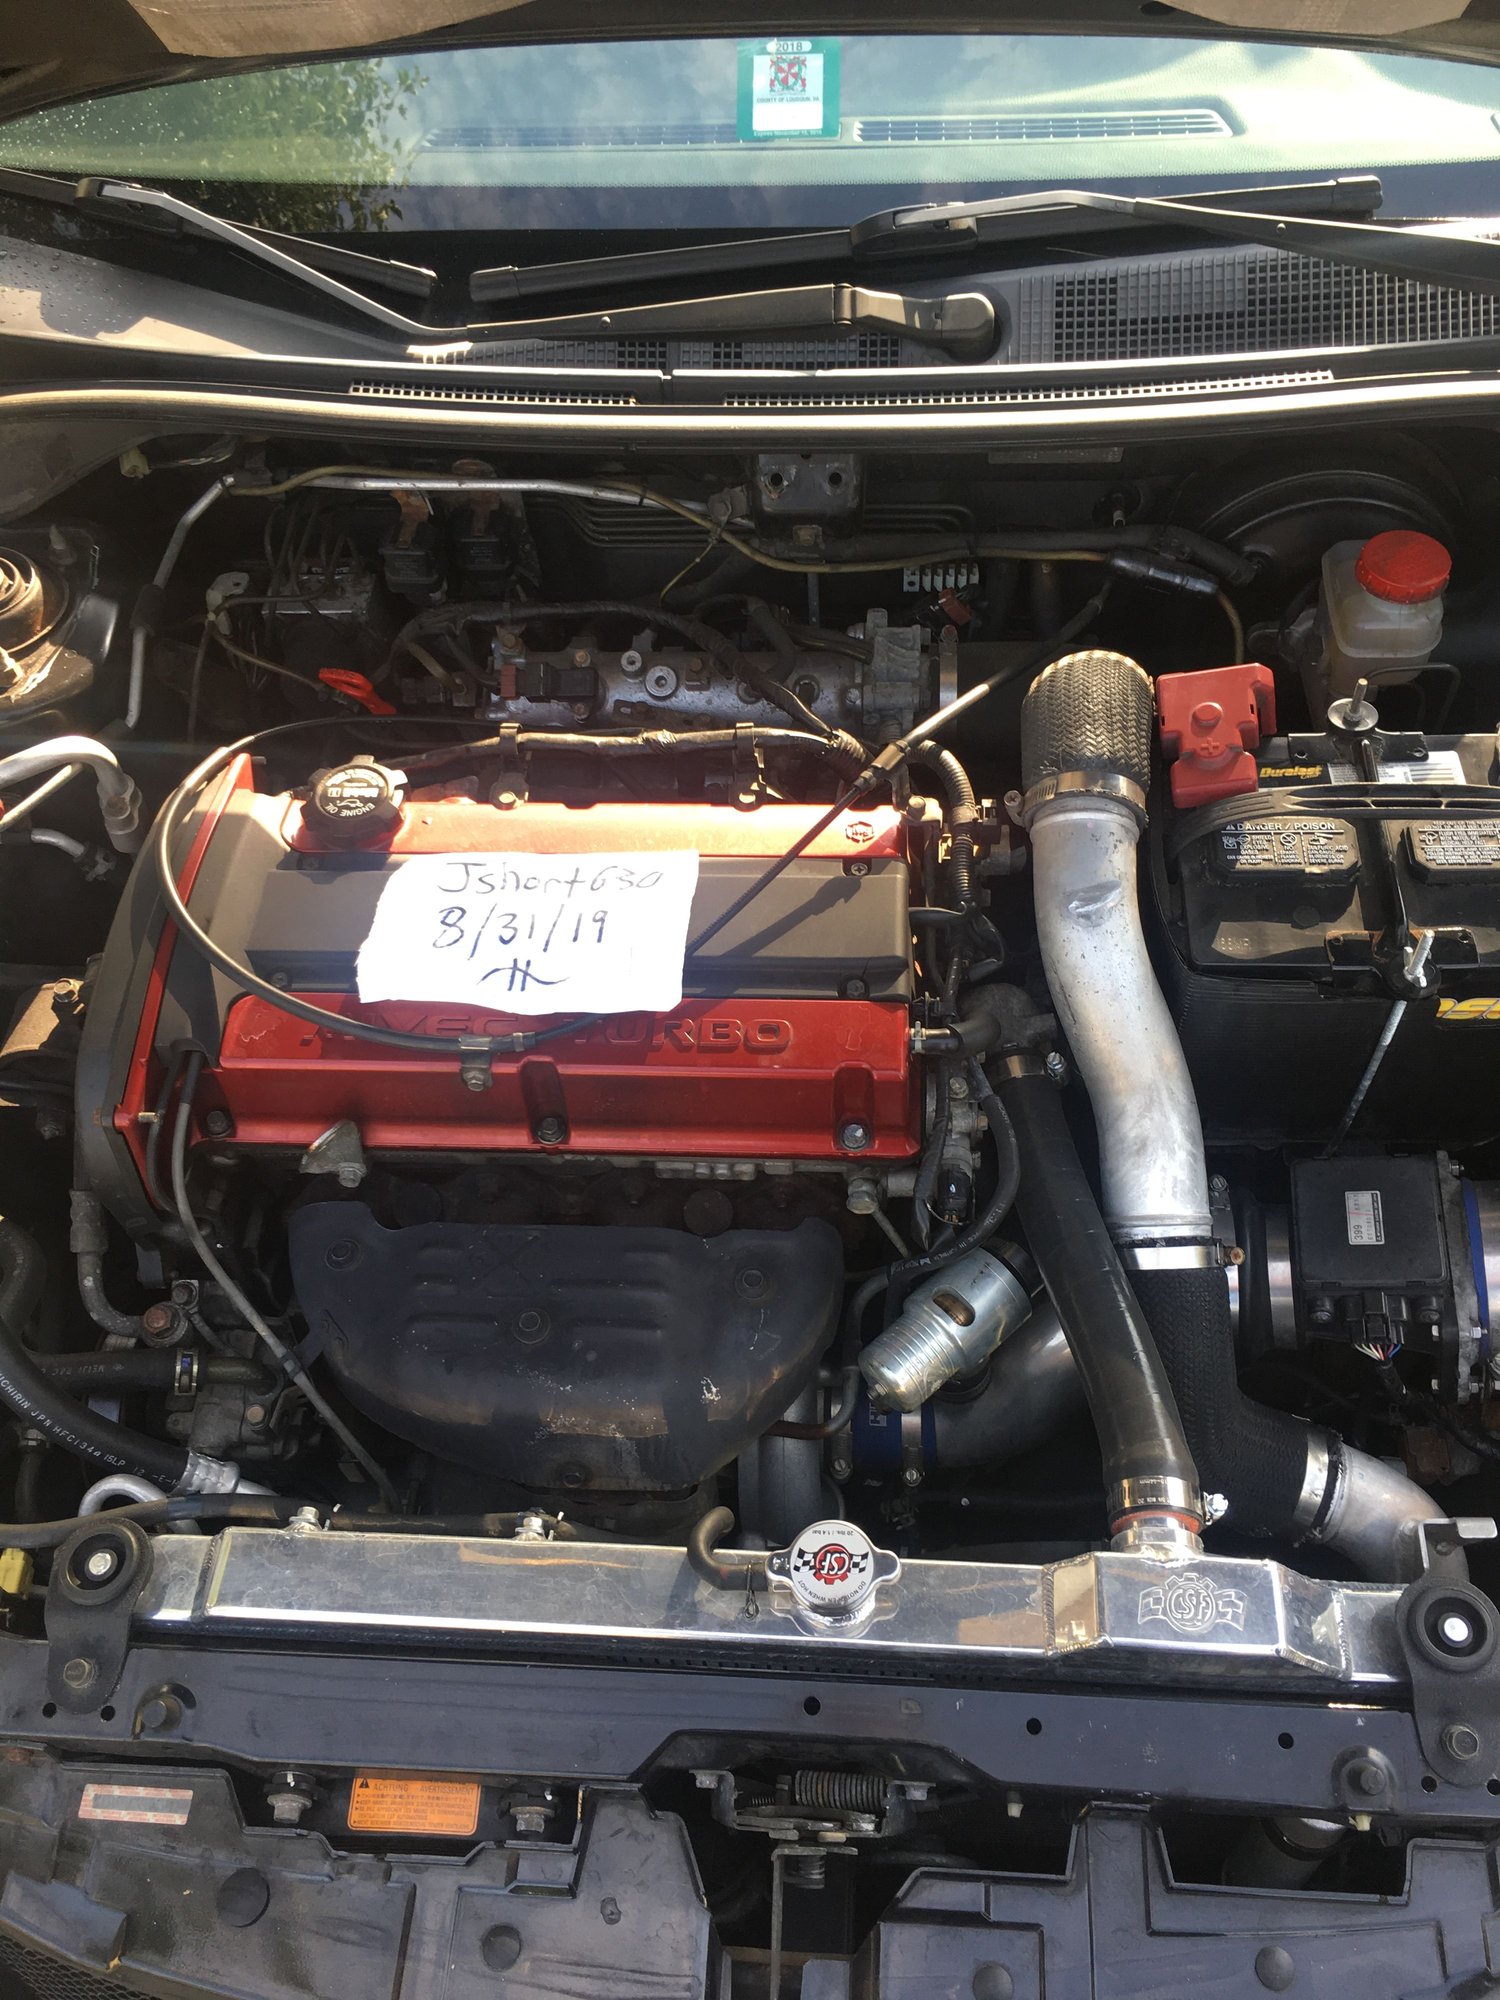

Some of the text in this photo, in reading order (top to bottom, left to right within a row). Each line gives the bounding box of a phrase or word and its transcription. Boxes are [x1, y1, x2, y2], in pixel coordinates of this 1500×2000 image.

[776, 42, 803, 52] 2018
[1260, 764, 1323, 778] Duralast
[324, 802, 376, 816] ENGINE OIL
[1237, 822, 1282, 830] DANGER
[432, 903, 608, 961] 8/31/19
[1353, 1224, 1364, 1240] 399
[31, 1410, 51, 1428] JPN
[53, 1425, 102, 1458] HFC134a
[104, 1453, 127, 1467] 15LP
[772, 1556, 790, 1571] 1.4
[820, 1552, 849, 1575] CSF
[798, 1580, 809, 1592] HOT
[858, 1581, 866, 1590] DO
[808, 1590, 826, 1603] WHEN
[846, 1590, 858, 1600] NOT
[1172, 1588, 1211, 1620] CSF
[374, 1784, 474, 1794] ACHTUNG AVERTISSEMENT
